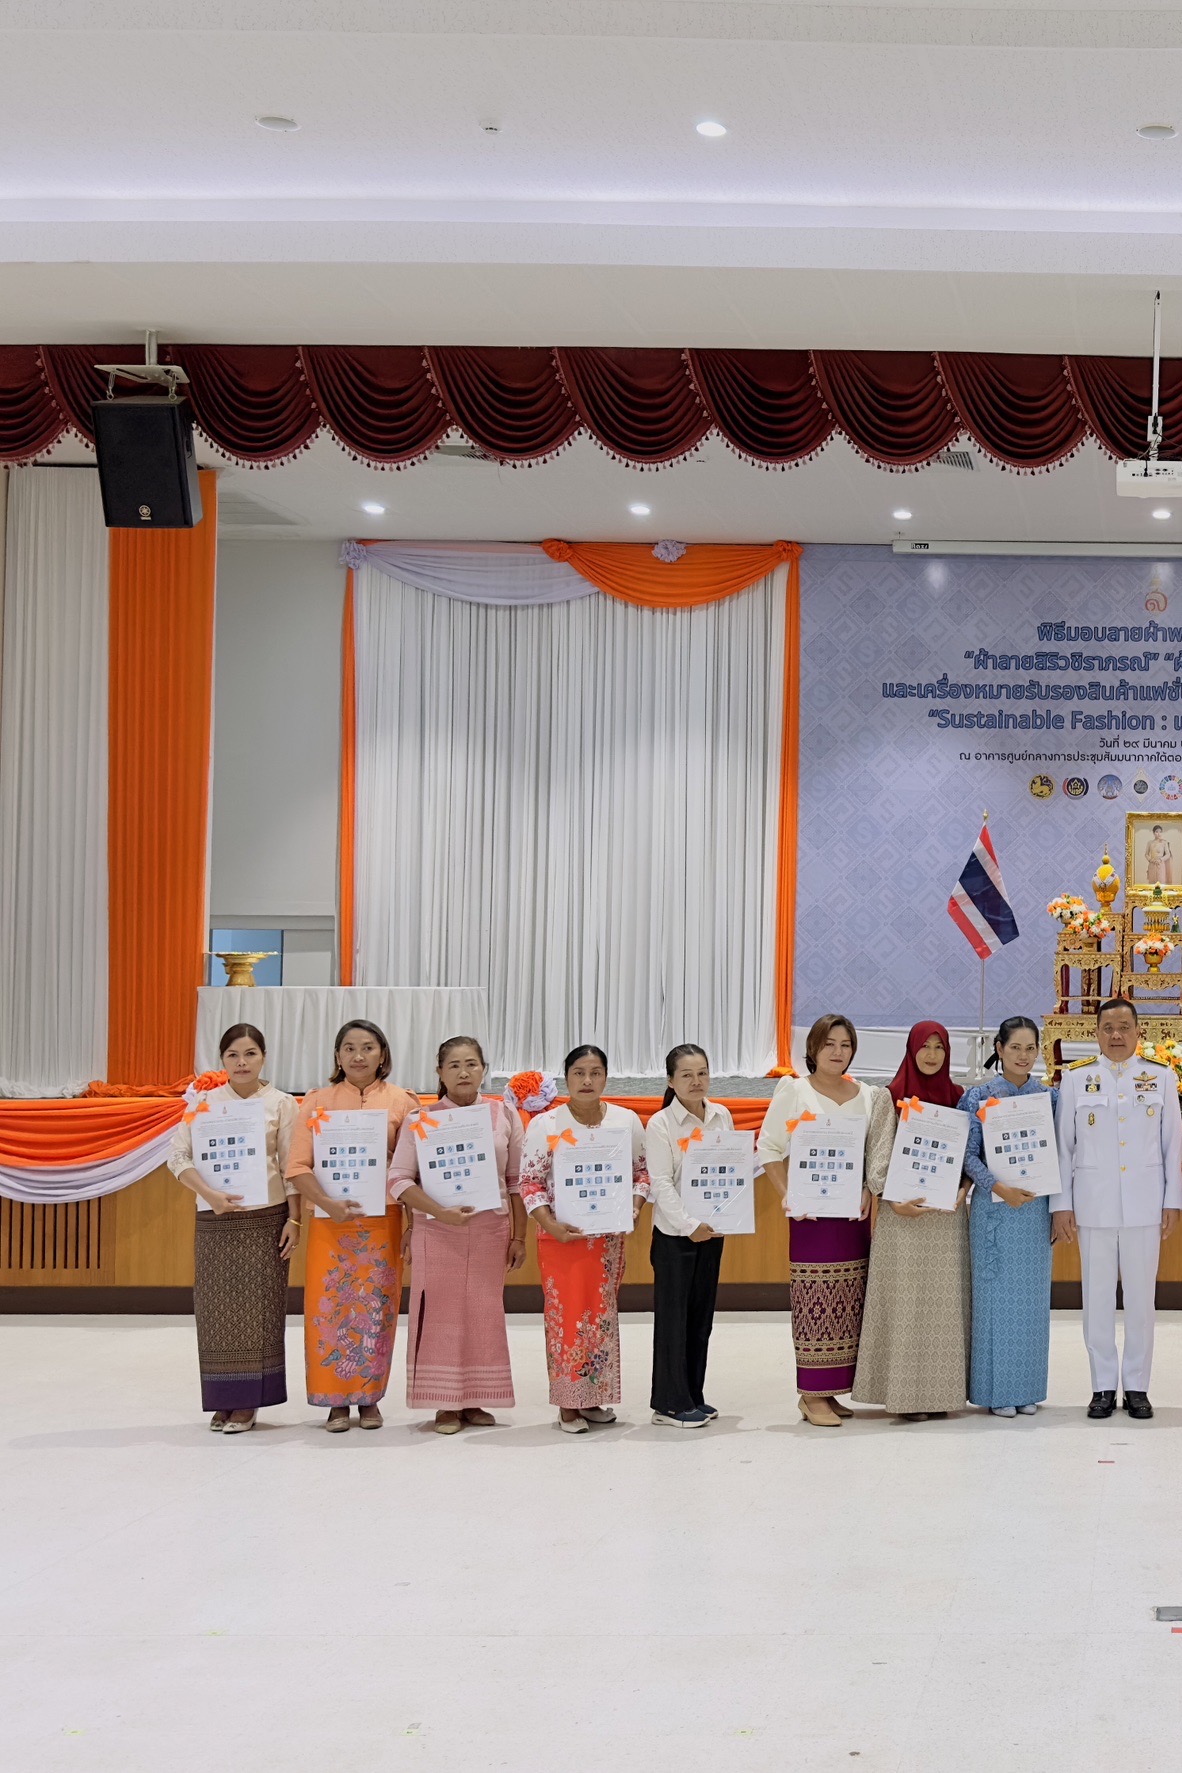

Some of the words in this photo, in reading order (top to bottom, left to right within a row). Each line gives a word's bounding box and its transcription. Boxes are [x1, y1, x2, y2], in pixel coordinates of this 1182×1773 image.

[928, 709, 1065, 729] “Sustainable
[1071, 710, 1155, 730] Fashion
[1099, 735, 1120, 748] วันที่
[1143, 738, 1177, 749] มีนาคม
[959, 752, 971, 761] ณ
